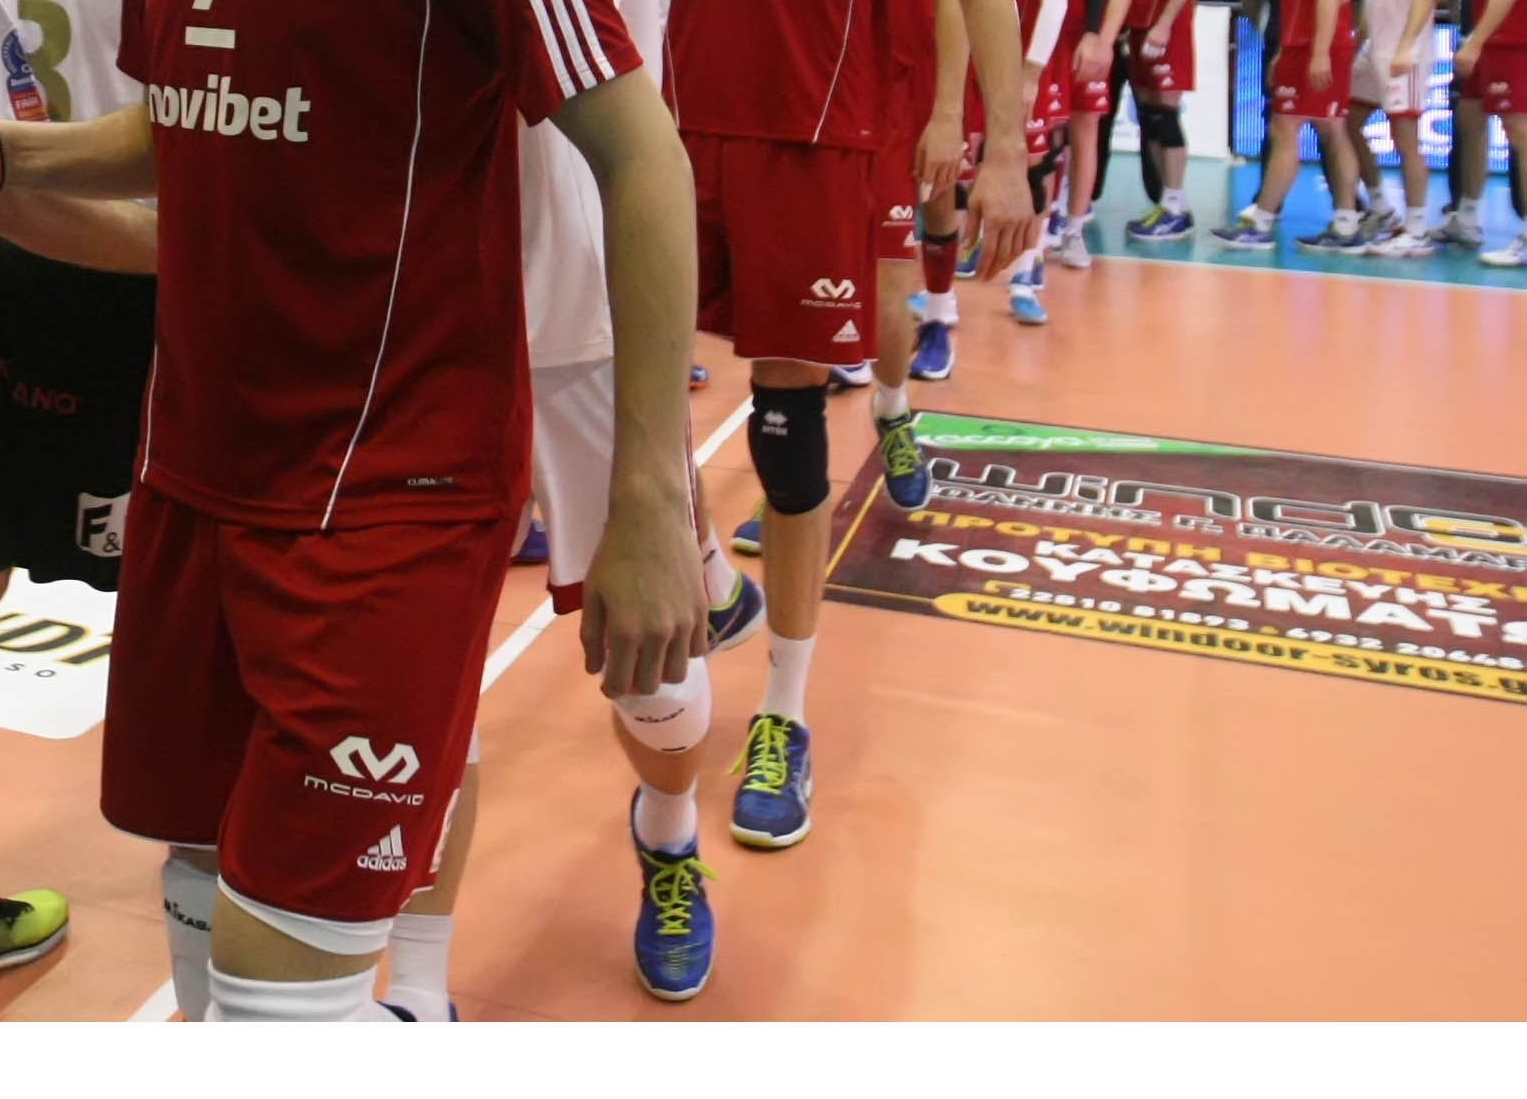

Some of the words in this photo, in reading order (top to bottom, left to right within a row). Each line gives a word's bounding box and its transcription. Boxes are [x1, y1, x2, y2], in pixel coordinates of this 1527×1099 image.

[148, 73, 312, 142] novibet
[930, 483, 1162, 527] ΩΑΝΝΗΣ
[907, 510, 1222, 562] ΠΡΟΤΥΠΗ
[1034, 540, 1498, 616] ΚΑΤΑΣΚΕΥΗΣ
[965, 599, 1527, 696] www.windoor-syros.g
[356, 855, 407, 871] adidas
